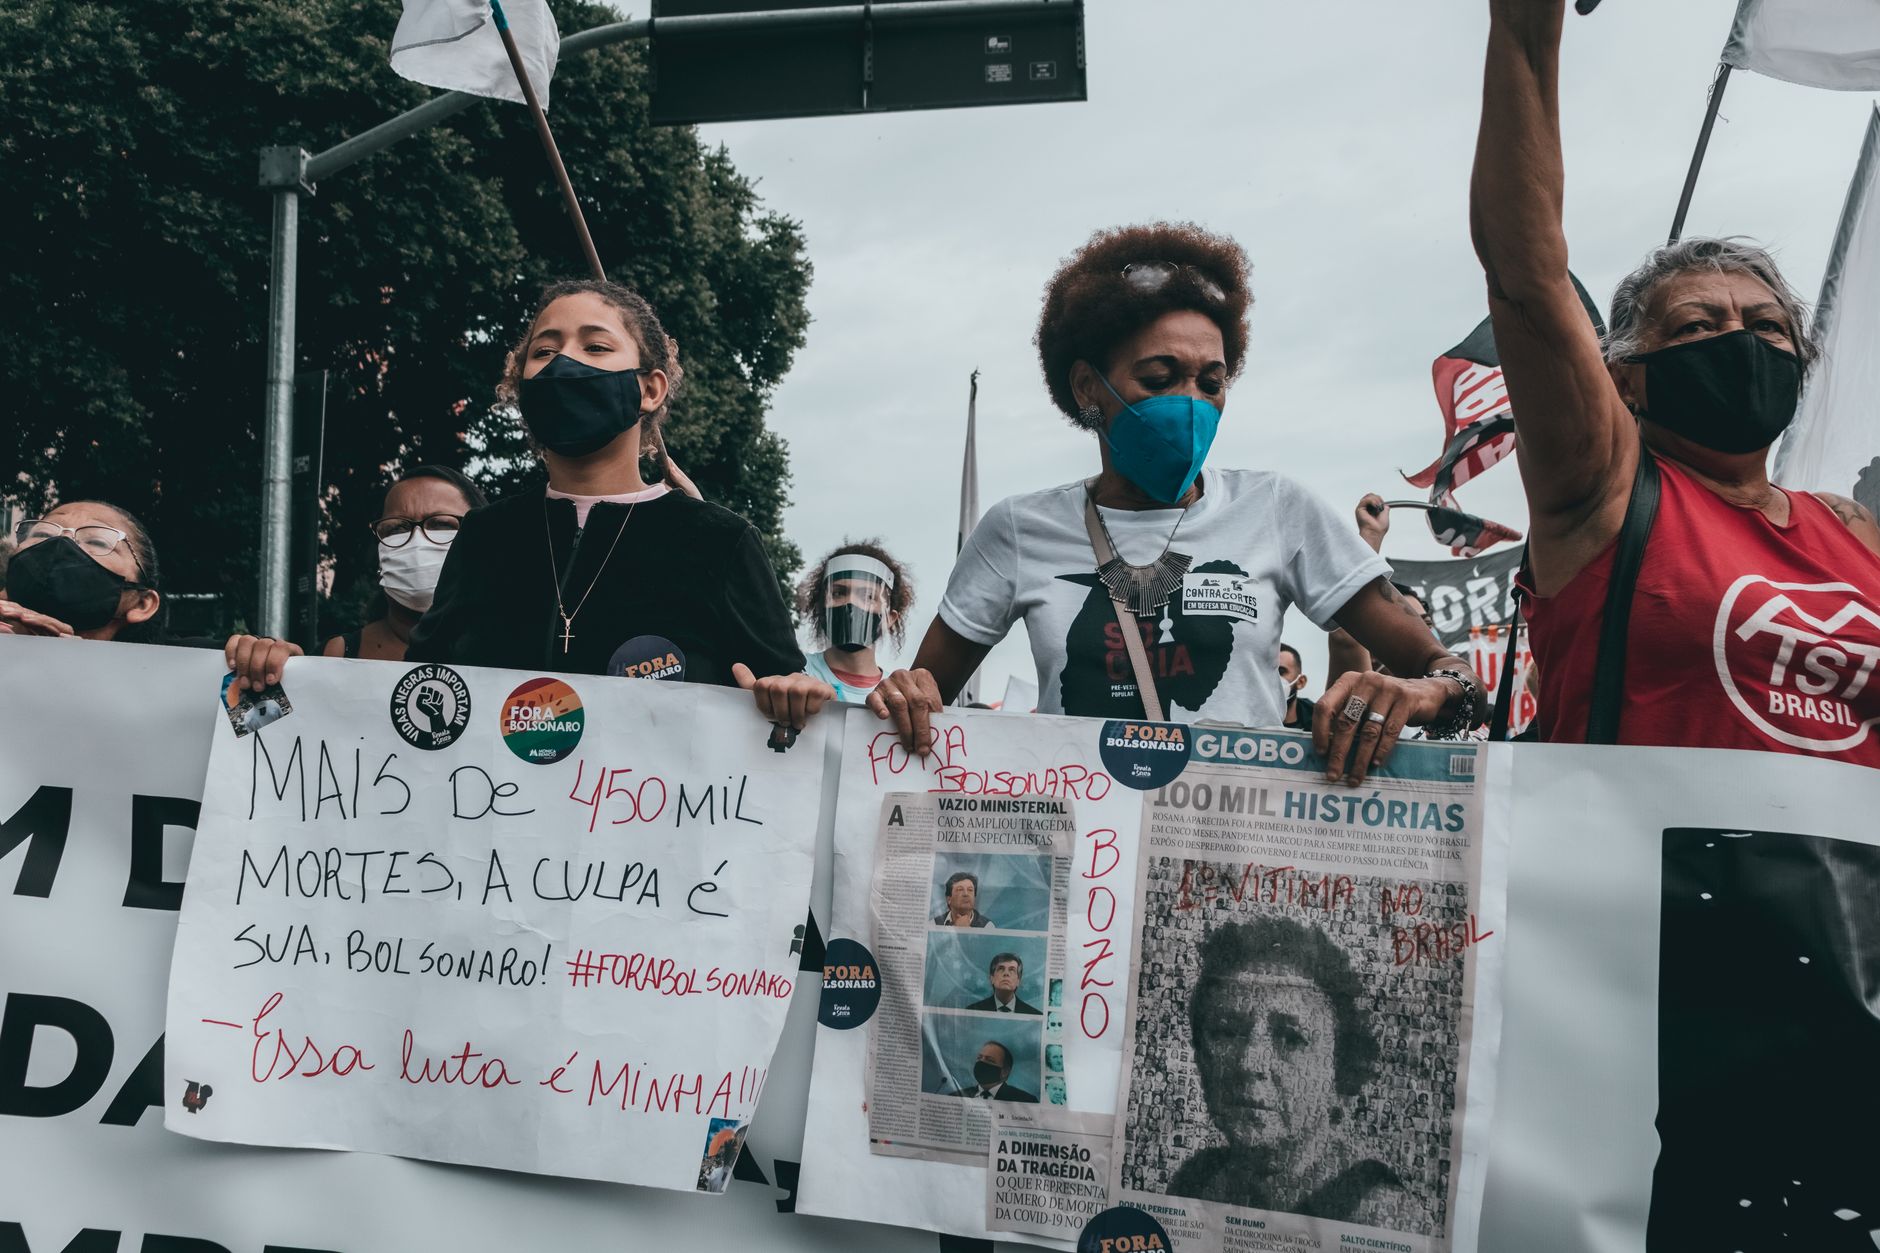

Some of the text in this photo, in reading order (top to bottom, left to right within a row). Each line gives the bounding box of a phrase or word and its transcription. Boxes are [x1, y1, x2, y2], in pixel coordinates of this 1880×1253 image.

[1185, 588, 1221, 598] CONTRA
[1222, 592, 1257, 607] CORTES
[1197, 602, 1219, 610] DEFESA
[1229, 604, 1255, 617] EDUCAÇÃO
[625, 652, 680, 680] FORA
[394, 667, 469, 742] VIDAS NEGRAS IMPORTAM
[510, 705, 555, 721] FORA
[1768, 690, 1857, 728] BRASIL
[509, 720, 581, 733] BOLSONARO
[1124, 724, 1184, 742] FORA
[867, 725, 967, 786] FORA
[1106, 738, 1185, 752] BOLSONARO
[1195, 734, 1304, 765] GLOBO
[249, 731, 411, 822] MAIS
[569, 760, 667, 832] 450
[927, 763, 1112, 801] BOLSONARO
[888, 805, 905, 827] A
[938, 798, 1067, 815] VAZIO MINISTERIAL
[1152, 780, 1464, 833] 100 MIL HISTÓRIAS
[937, 815, 965, 829] CAOS
[967, 816, 1018, 830] AMPLIOU
[1152, 812, 1185, 823] ROSANA
[1187, 815, 1229, 827] APARECIDA
[1231, 819, 1245, 829] FOI
[1247, 821, 1253, 829] A
[1254, 820, 1294, 833] PRIMEIRA
[1296, 826, 1313, 835] DAS
[1314, 828, 1328, 836] 100
[1329, 829, 1345, 838] MIL
[1346, 829, 1382, 841] VÍTIMAS
[1383, 833, 1395, 842] DE
[1396, 834, 1424, 844] COVID
[1425, 836, 1439, 845] NO
[937, 830, 1053, 846] DIZEM ESPECIALISTAS
[1151, 824, 1164, 834] EM
[1165, 826, 1191, 835] CINCO
[1221, 831, 1264, 843] PANDEMIA
[1266, 835, 1302, 846] MARCOU
[1304, 839, 1325, 848] PARA
[1326, 841, 1360, 852] SEMPRE
[1362, 844, 1406, 855] MILHARES
[1407, 847, 1420, 856] DE
[1150, 836, 1176, 846] EXPÔS
[1185, 840, 1236, 852] DESPREPARO
[1237, 845, 1250, 854] DO
[1250, 846, 1292, 858] GOVERNO
[1293, 851, 1298, 859] E
[1299, 851, 1343, 863] ACELEROU
[1344, 855, 1351, 863] O
[1352, 856, 1379, 866] PASSO
[1380, 858, 1392, 867] DA
[1393, 857, 1429, 870] CIÊNCIA
[236, 845, 462, 905] MORTES,
[481, 848, 513, 905] A
[533, 857, 660, 907] CULPA
[1381, 883, 1424, 916] NO
[1392, 913, 1494, 967] BRASIL
[347, 929, 552, 987] BOLSONARO!
[823, 965, 875, 980] FORA
[252, 992, 375, 1083] Essa
[400, 1028, 521, 1088] luta
[539, 1051, 578, 1093] é
[997, 1140, 1091, 1163] A DIMENSÃO
[997, 1158, 1096, 1181] DA TRAGÉDIA
[996, 1175, 1106, 1199] O QUE REPRESENTA
[996, 1189, 1047, 1208] NÚMERO
[1049, 1196, 1065, 1210] DE
[1147, 1205, 1187, 1217] PERIFERIA
[995, 1207, 1011, 1220] DA
[1013, 1208, 1063, 1226] COVID-19
[1064, 1215, 1083, 1230] NO
[1179, 1218, 1189, 1228] DE
[1225, 1215, 1266, 1229] SEM RUMO
[1100, 1233, 1164, 1253] FORA
[1224, 1226, 1234, 1235] DA
[1234, 1227, 1282, 1242] CLOROQUINA
[1294, 1236, 1321, 1248] TROCAS
[1340, 1233, 1412, 1253] SALTO CIENTÍFICO
